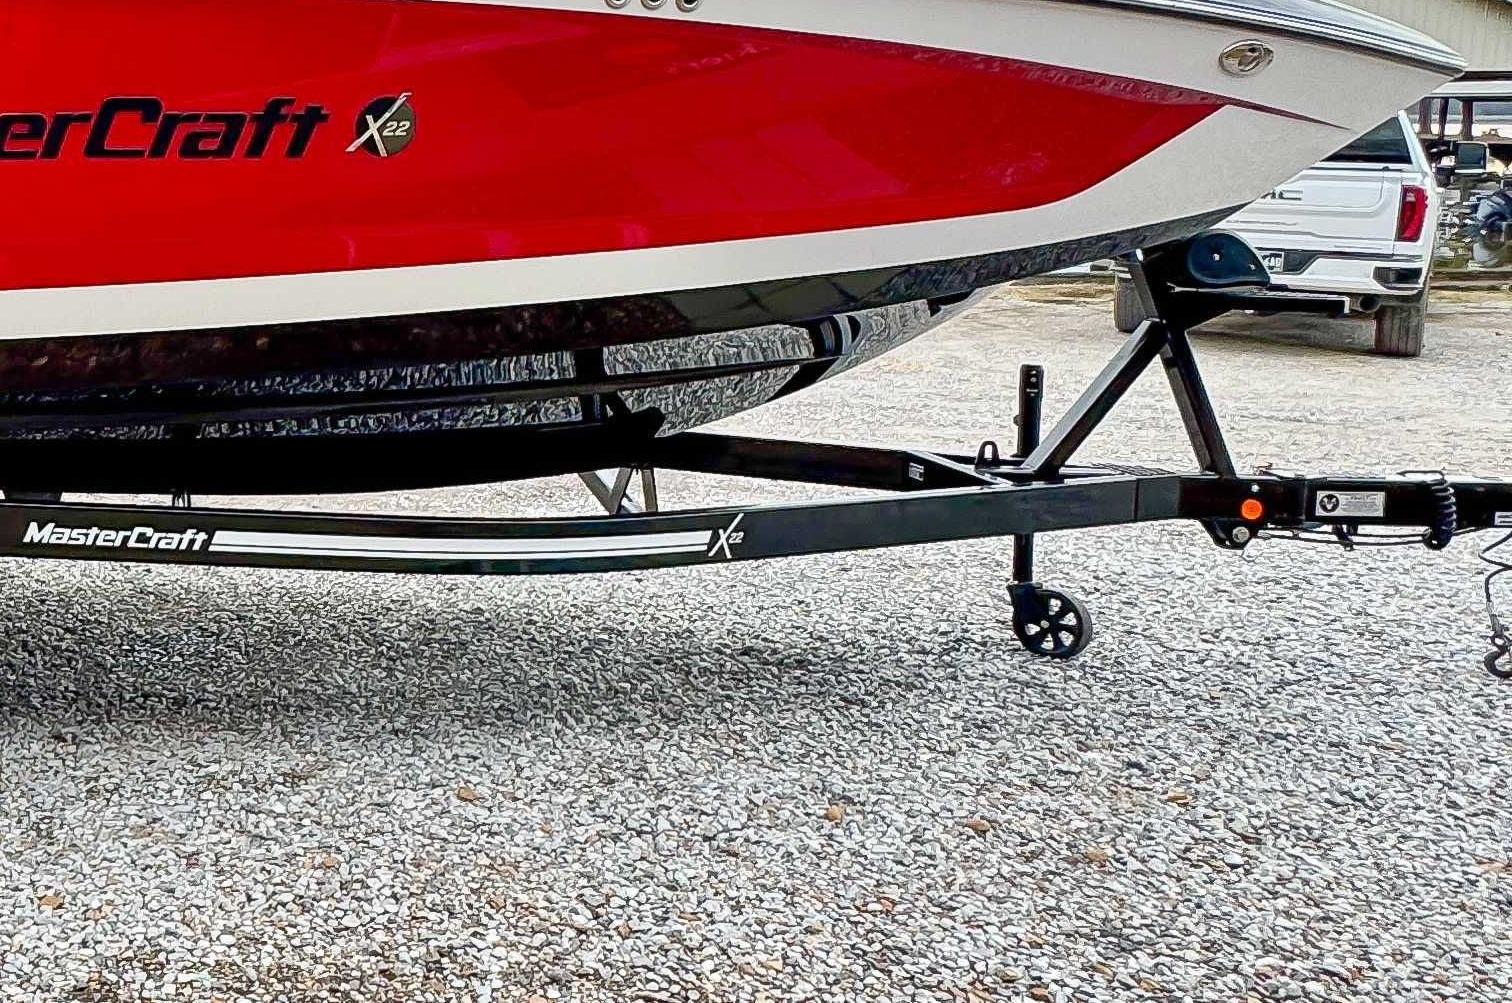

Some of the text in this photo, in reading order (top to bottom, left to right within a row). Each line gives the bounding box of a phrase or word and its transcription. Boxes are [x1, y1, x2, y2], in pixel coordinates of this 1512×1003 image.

[345, 92, 412, 157] X22
[22, 521, 208, 551] MasterCraft
[708, 512, 744, 559] X22
